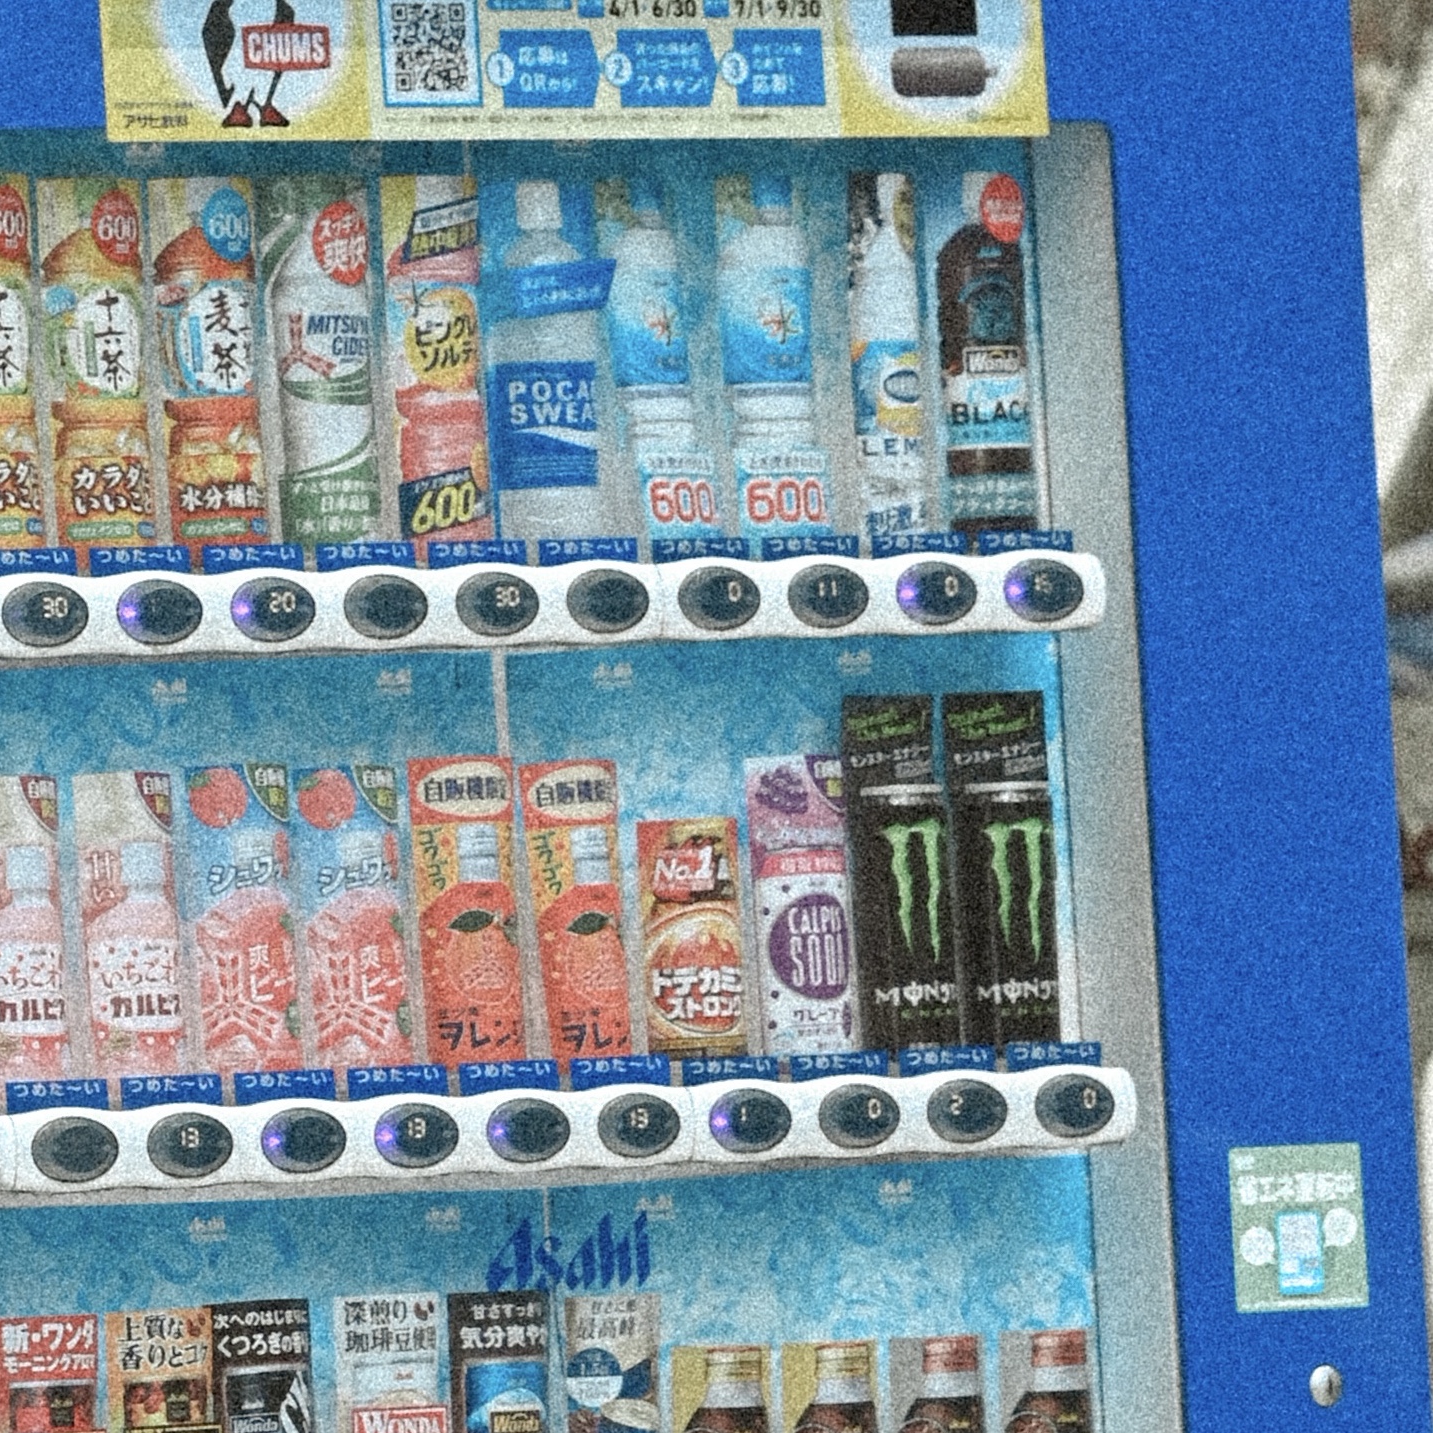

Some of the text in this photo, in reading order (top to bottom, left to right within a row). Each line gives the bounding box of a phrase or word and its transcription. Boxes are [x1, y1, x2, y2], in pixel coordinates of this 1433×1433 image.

[247, 29, 326, 64] CHUMS
[97, 214, 135, 241] 600
[209, 213, 248, 239] 600
[94, 289, 132, 391] 十六茶
[412, 484, 477, 534] 600
[649, 479, 716, 524] 600
[746, 479, 826, 524] 600
[117, 1315, 183, 1342] 上質な
[345, 1301, 407, 1326] 深煎り
